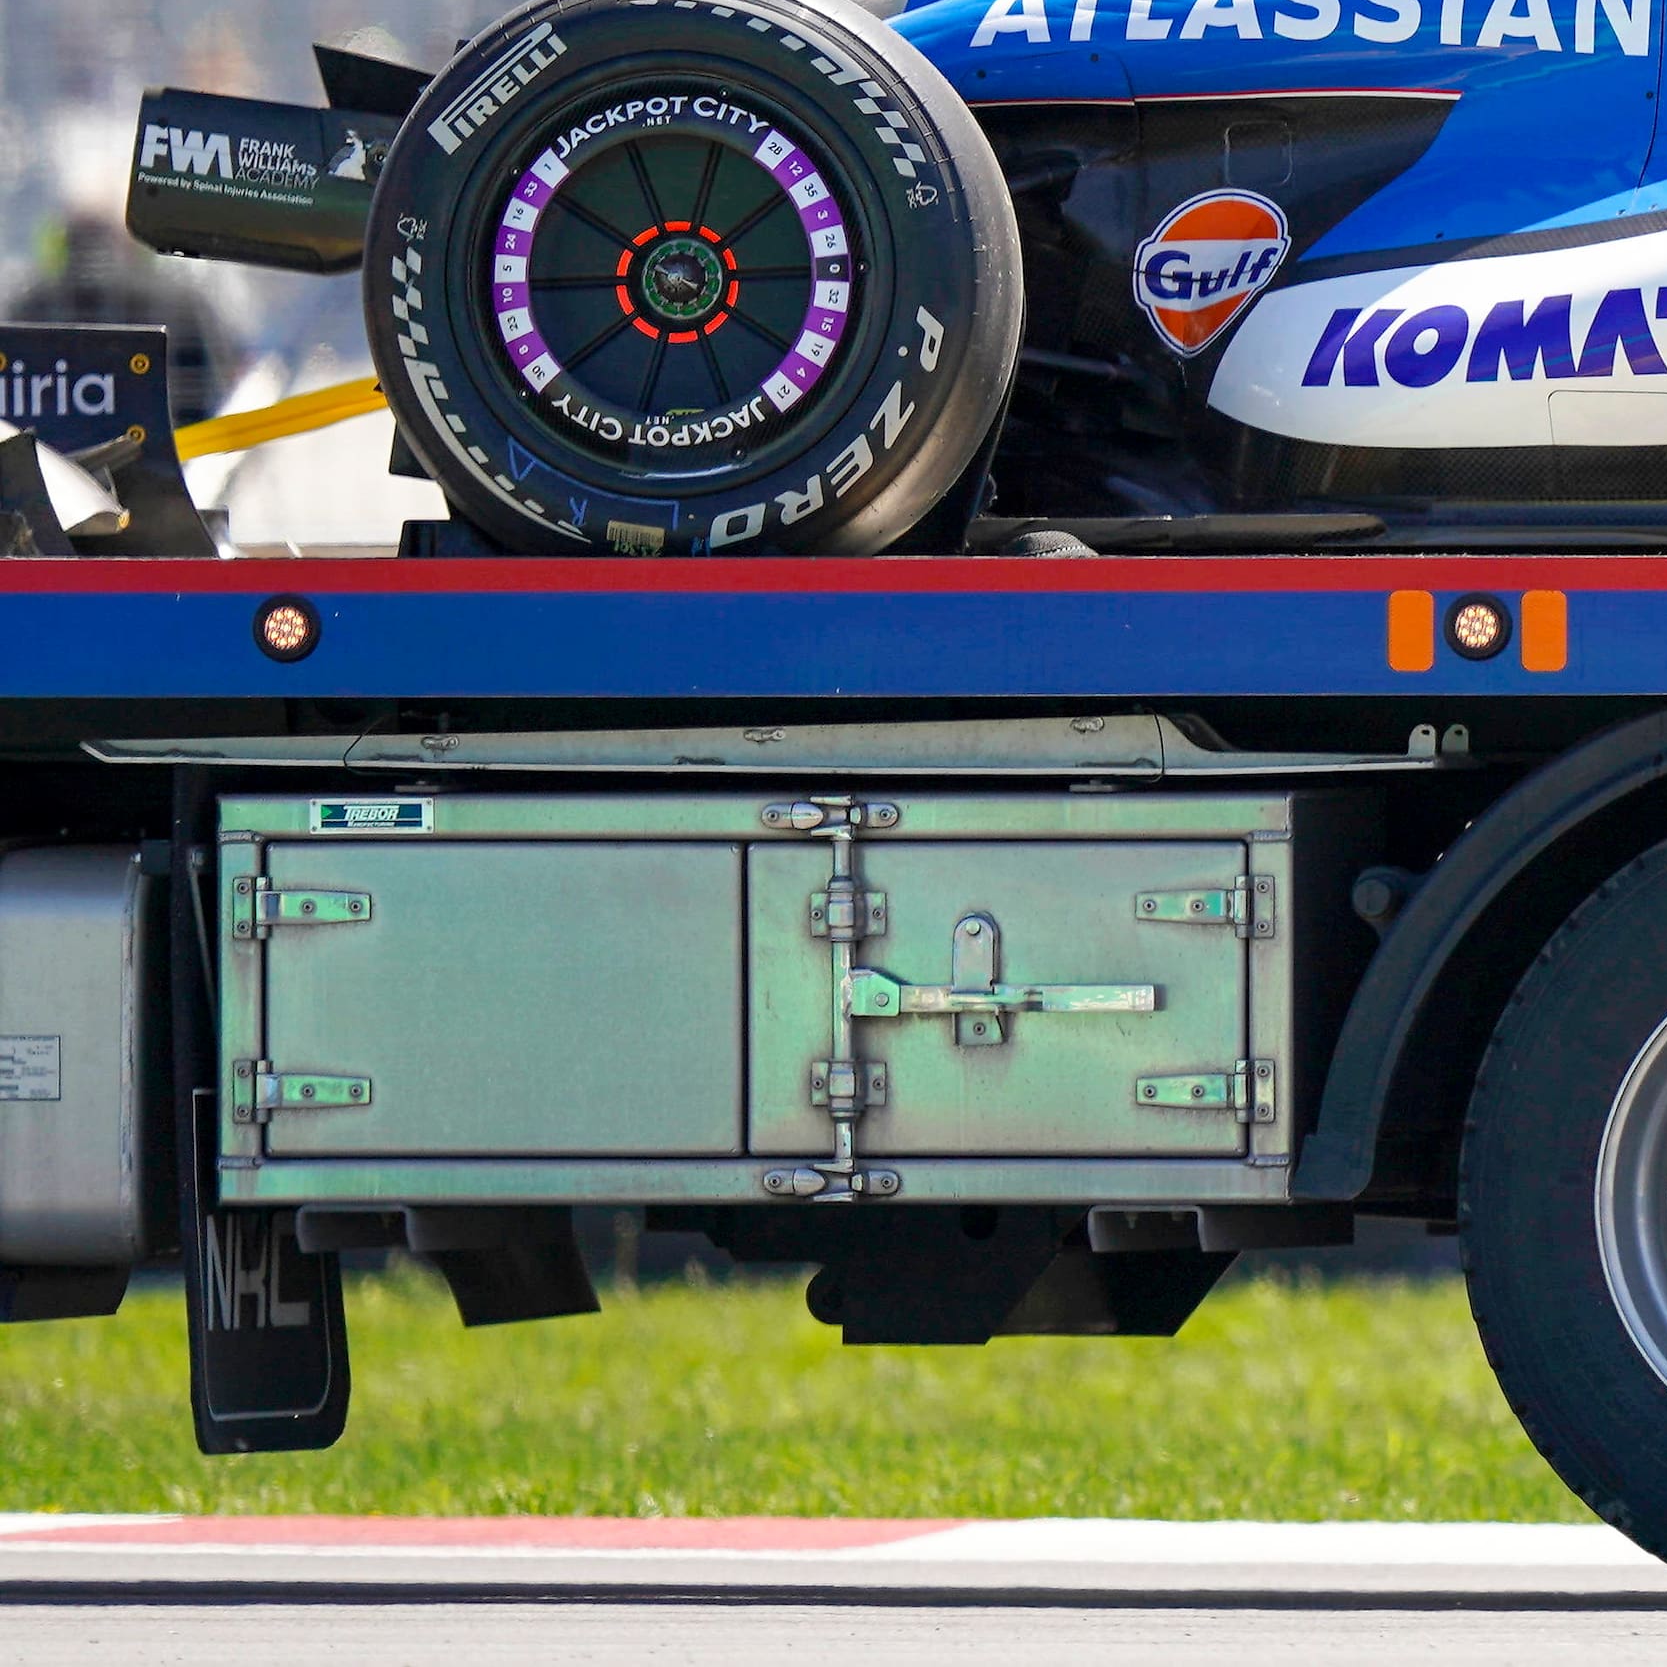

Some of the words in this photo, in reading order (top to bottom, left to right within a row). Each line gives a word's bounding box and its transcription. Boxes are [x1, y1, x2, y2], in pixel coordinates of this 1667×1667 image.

[427, 21, 568, 156] PIRELLI
[556, 96, 688, 159] JACKPOT
[693, 97, 769, 134] CITY
[239, 138, 296, 159] FRANK
[768, 141, 782, 156] 28
[238, 152, 317, 177] WILLIAMS
[789, 161, 803, 177] 12
[234, 169, 320, 190] ACADEMY
[137, 171, 179, 188] Powered
[180, 178, 192, 190] by
[193, 180, 224, 195] Spinal
[224, 185, 260, 200] Injuries
[260, 190, 314, 206] Association
[523, 182, 538, 198] 33
[804, 183, 818, 198] 35
[513, 207, 523, 221] 16
[505, 234, 516, 249] 24
[824, 233, 835, 249] 26
[1145, 247, 1279, 299] Gulf
[502, 287, 513, 303] 10
[829, 288, 840, 304] 32
[506, 316, 519, 332] 23
[820, 316, 834, 333] 15
[811, 343, 823, 356] 19
[531, 365, 546, 381] 30
[0, 359, 115, 416] iria
[777, 385, 790, 400] 21
[551, 393, 623, 441] CITY
[628, 396, 767, 447] JACKPOT
[709, 380, 916, 549] ZERO
[343, 805, 400, 821] TREBOR
